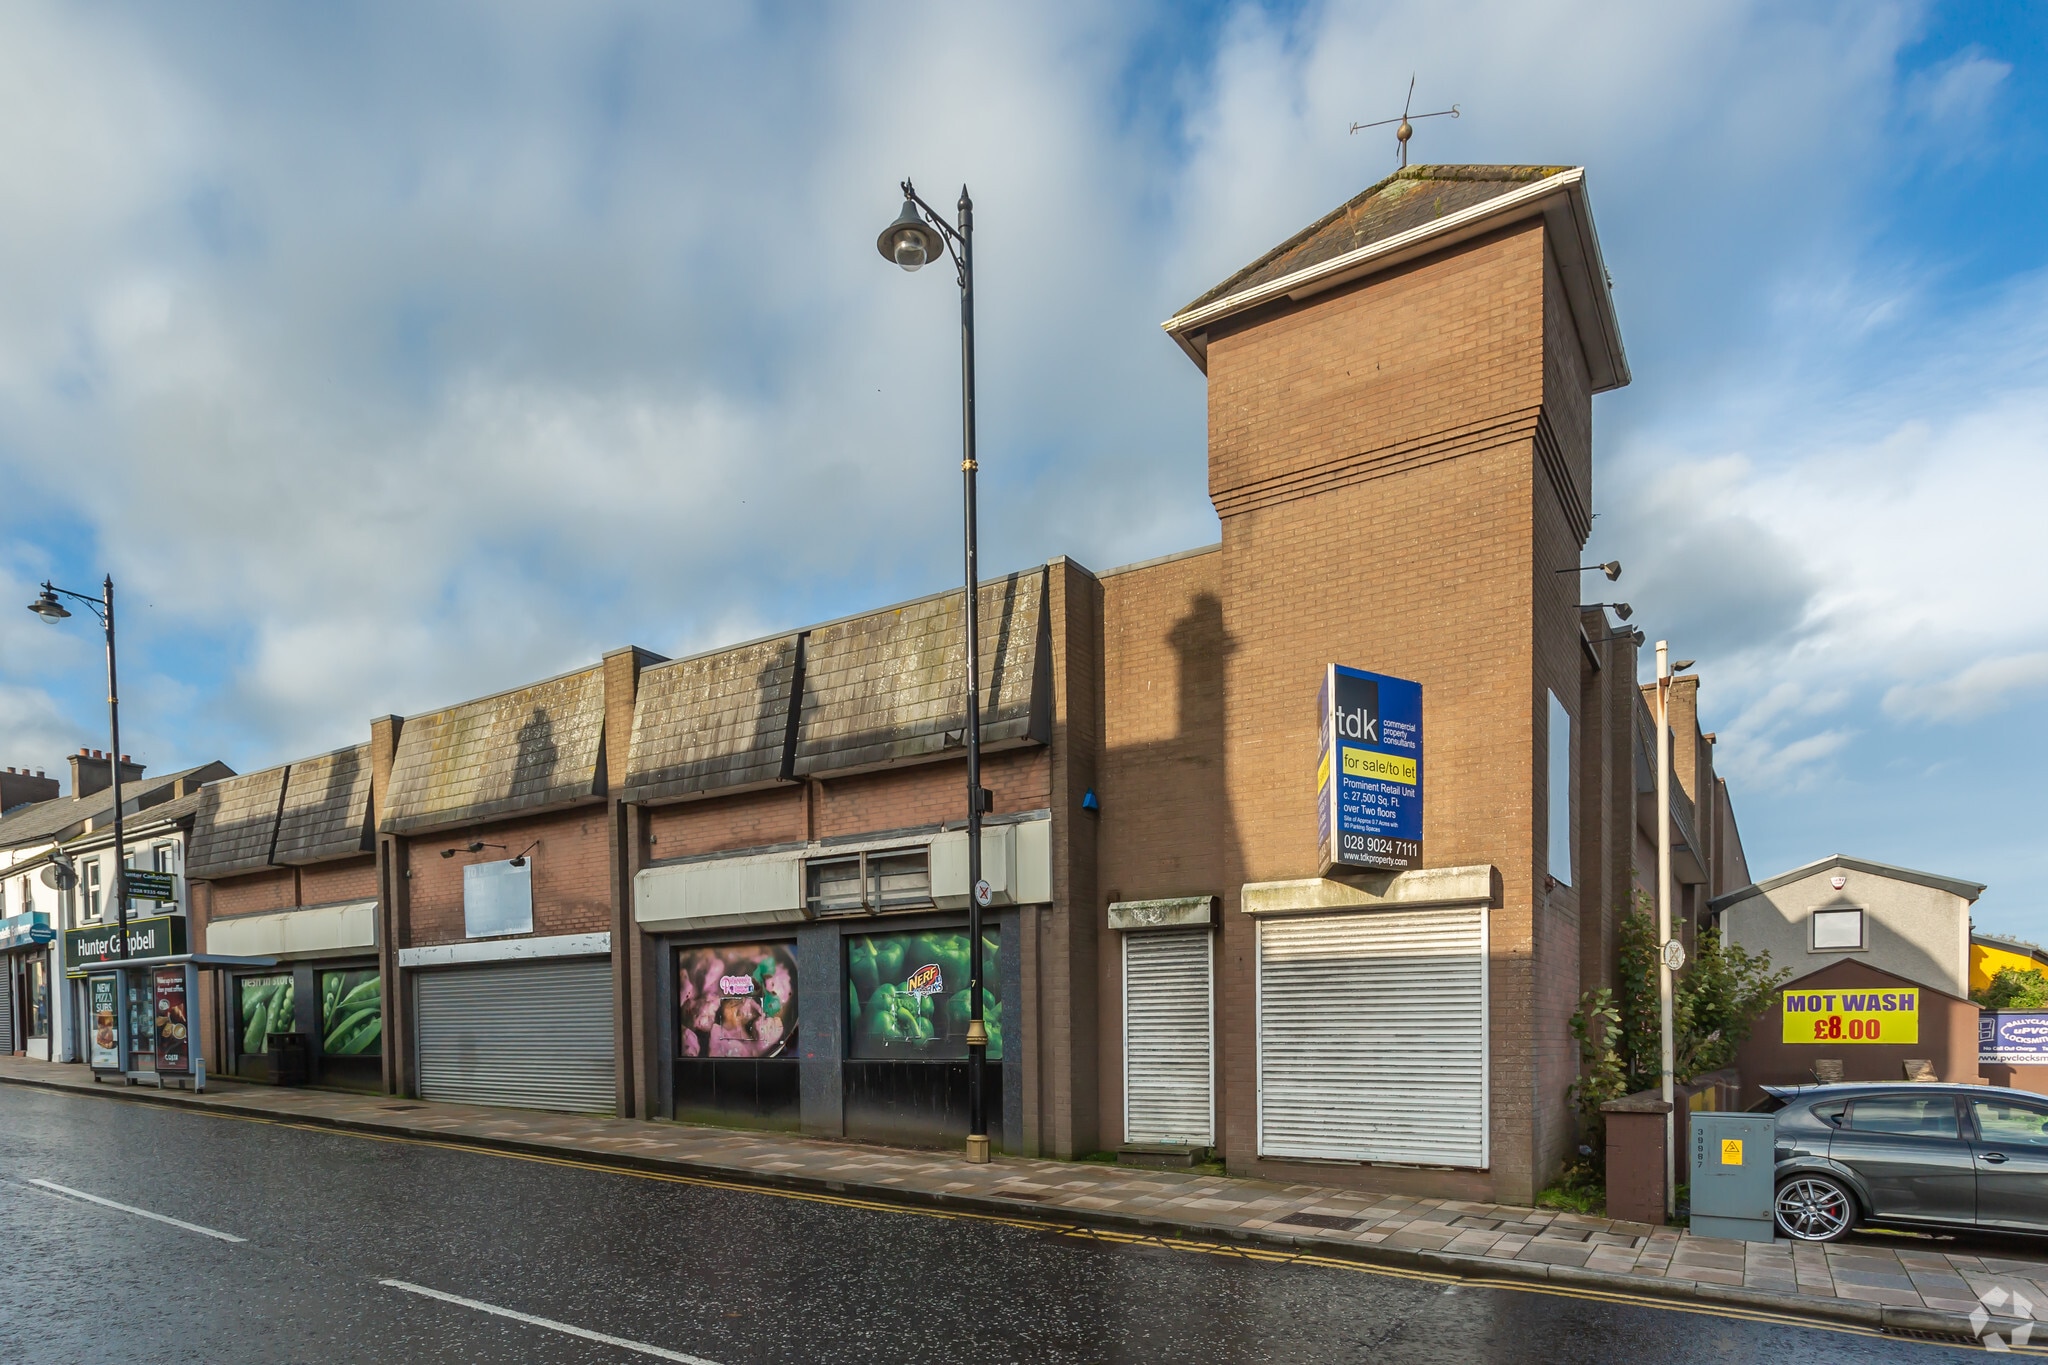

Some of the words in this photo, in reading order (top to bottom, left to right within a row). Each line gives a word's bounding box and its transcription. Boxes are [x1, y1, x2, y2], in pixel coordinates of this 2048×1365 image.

[1336, 706, 1377, 741] tdk
[1383, 720, 1416, 732] commercial
[1383, 728, 1408, 739] property
[1383, 736, 1416, 748] consultants
[1344, 754, 1359, 768] for
[1363, 760, 1399, 776] sale/to
[1403, 764, 1415, 778] let
[1343, 778, 1379, 792] Prominent
[1381, 783, 1400, 794] Retail
[1402, 787, 1415, 797] Unit
[1378, 796, 1389, 807] Sq.
[1344, 804, 1359, 813] over
[1361, 805, 1375, 816] Two
[1378, 808, 1396, 818] floors
[1350, 823, 1365, 831] Parking
[1344, 834, 1364, 850] 028
[1367, 838, 1392, 854] 9024
[1396, 841, 1417, 856] 7111
[1344, 852, 1408, 866] www.tdkproperty.com
[78, 939, 108, 956] Hunter
[909, 966, 936, 992] NERF
[971, 980, 976, 988] 7
[97, 983, 110, 992] NEW
[96, 993, 112, 1002] PIZZA
[1787, 995, 1836, 1012] MOT
[1842, 994, 1914, 1011] WASH
[1814, 1016, 1880, 1040] £8.00
